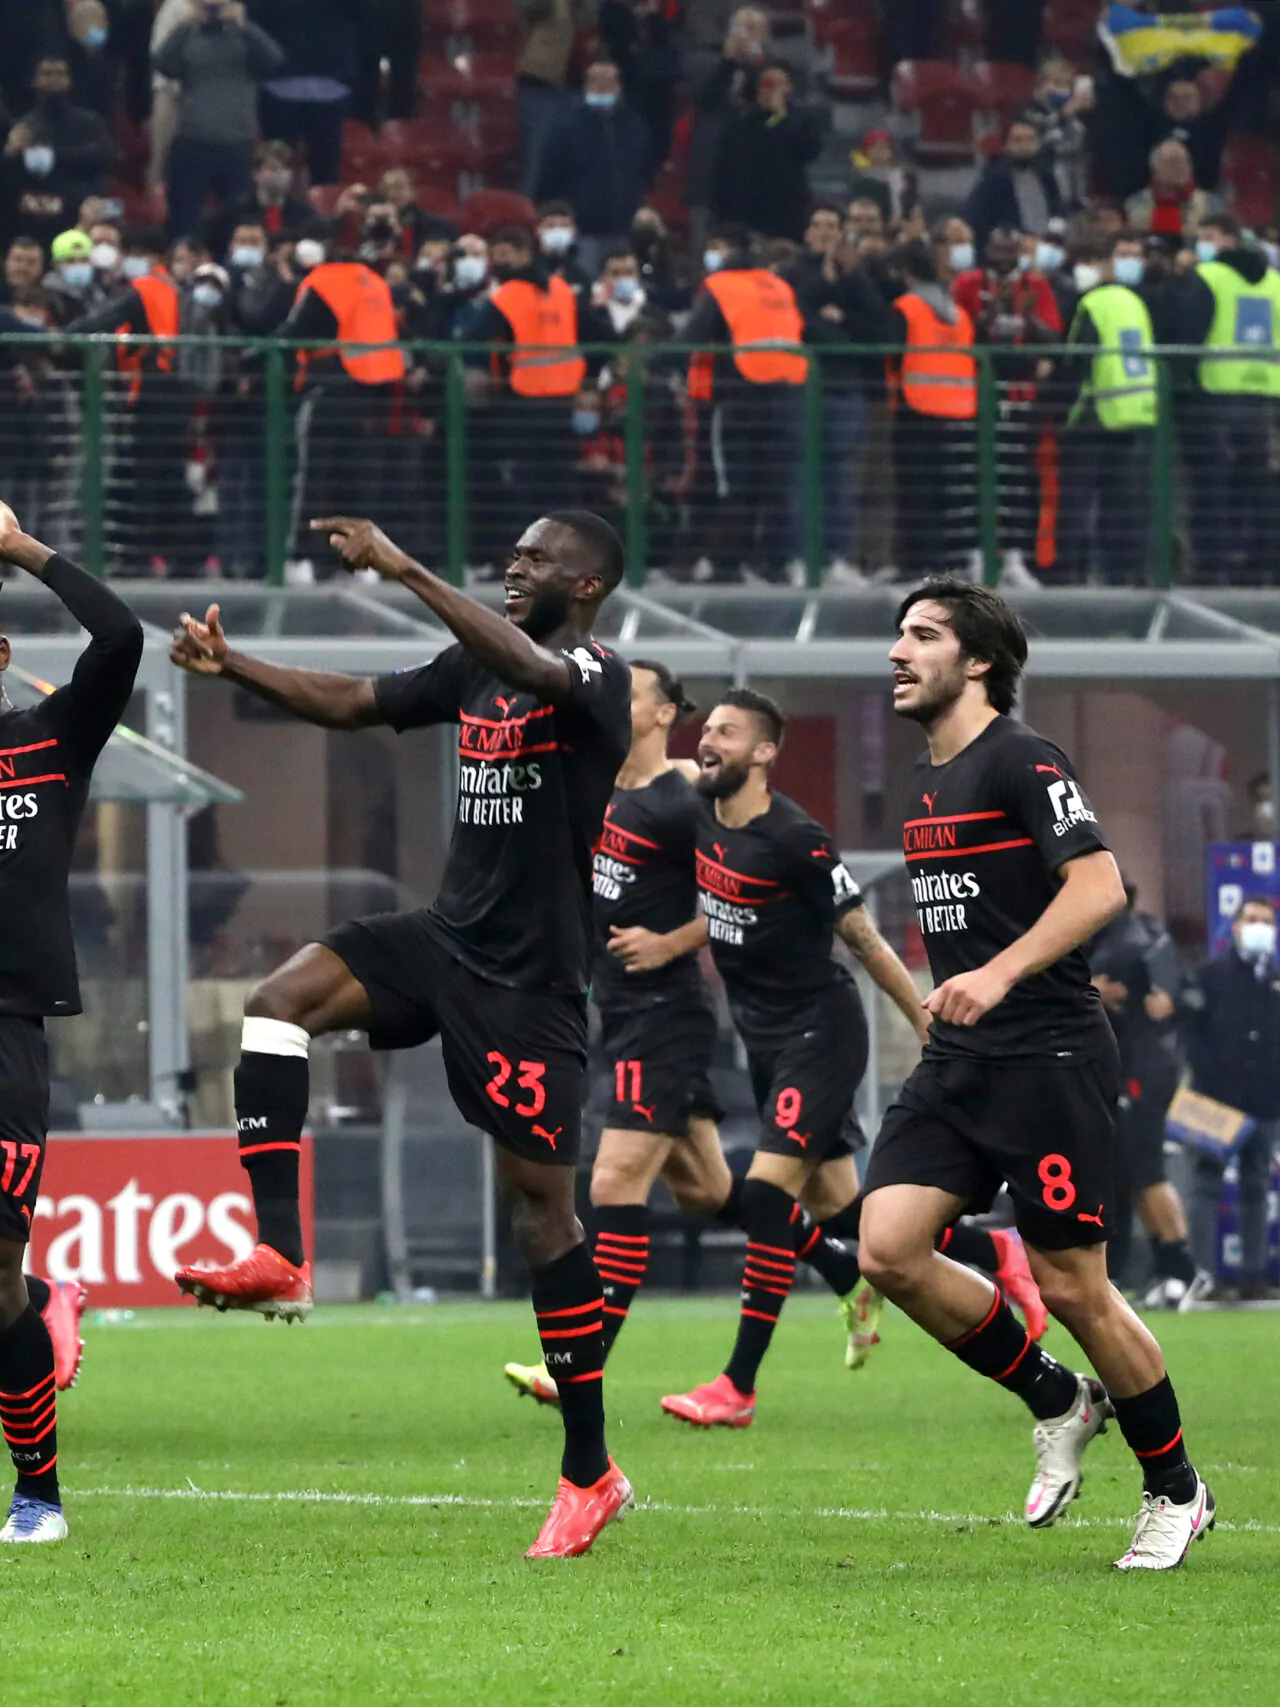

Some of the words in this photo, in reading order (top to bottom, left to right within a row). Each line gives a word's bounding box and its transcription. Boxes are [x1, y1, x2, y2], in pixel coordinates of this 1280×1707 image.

[473, 797, 523, 826] BETTER
[926, 904, 968, 933] BETTER
[485, 1050, 546, 1117] 23
[615, 1061, 641, 1102] 11
[775, 1087, 802, 1128] 9
[0, 1140, 40, 1197] 17
[1038, 1153, 1076, 1210] 8
